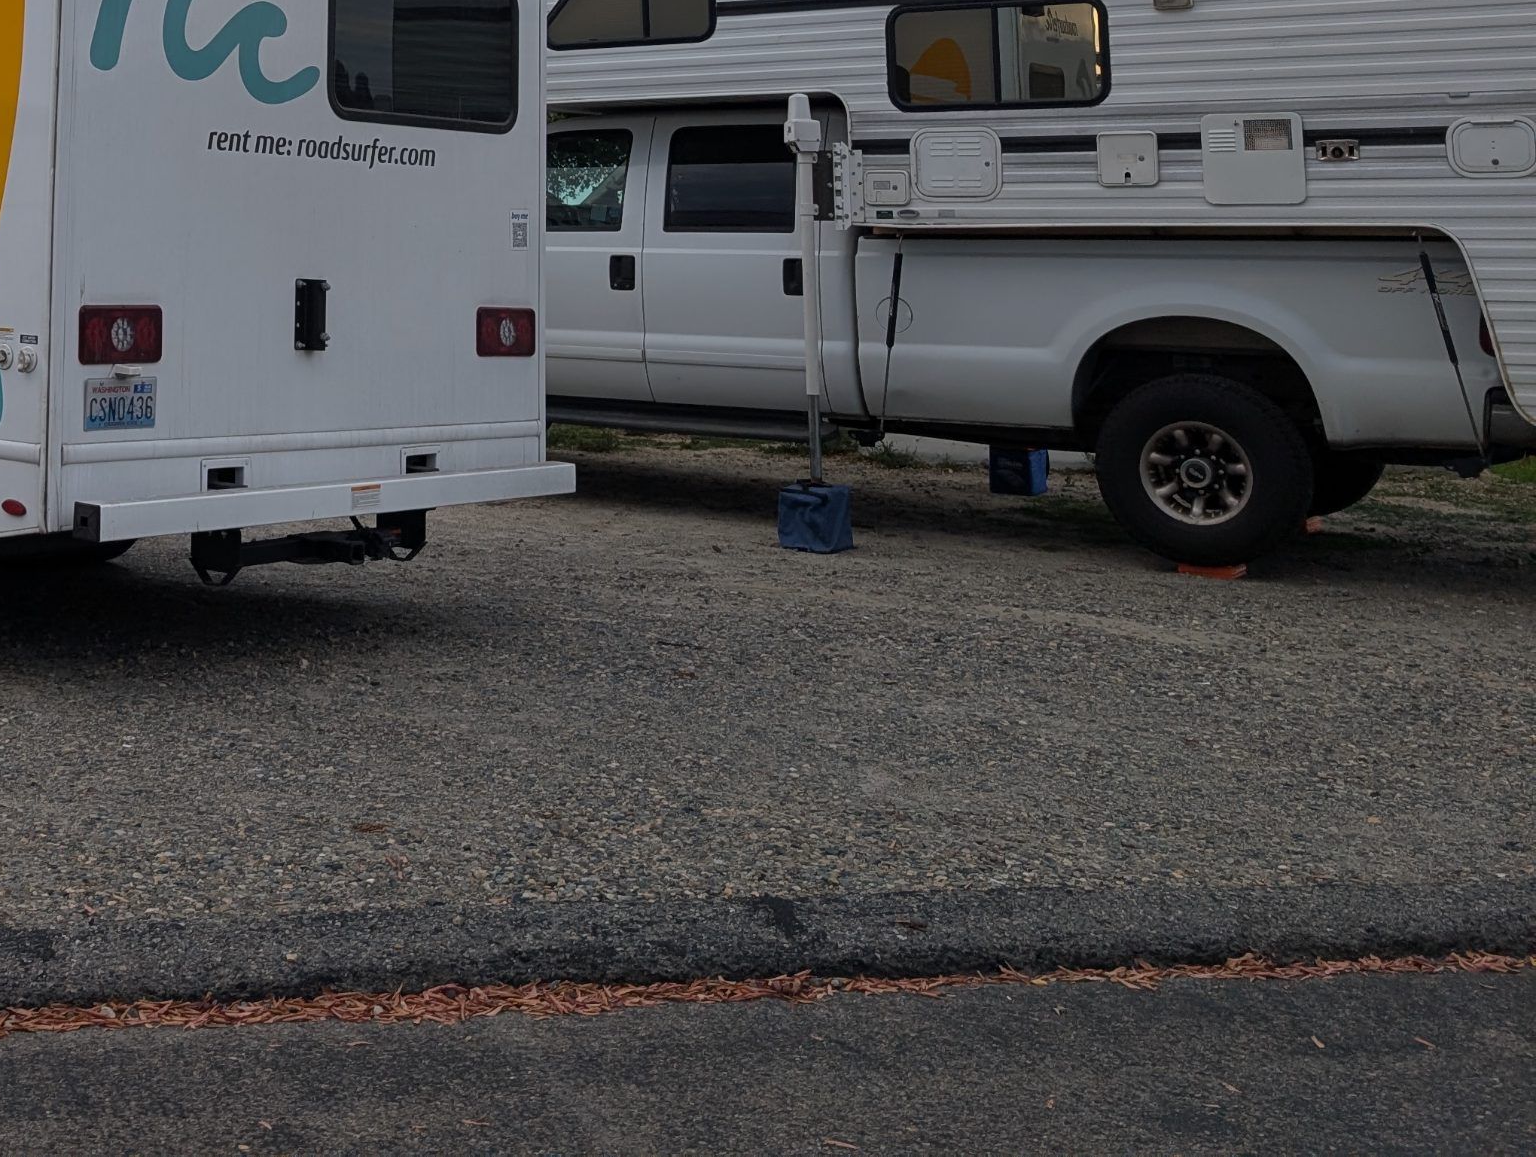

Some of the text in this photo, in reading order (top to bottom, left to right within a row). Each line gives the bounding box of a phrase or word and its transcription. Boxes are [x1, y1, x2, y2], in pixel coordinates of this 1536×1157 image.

[207, 129, 437, 170] rent me: roadsurfer.com
[92, 386, 131, 394] WASHINGTON
[90, 396, 153, 422] CSN0436
